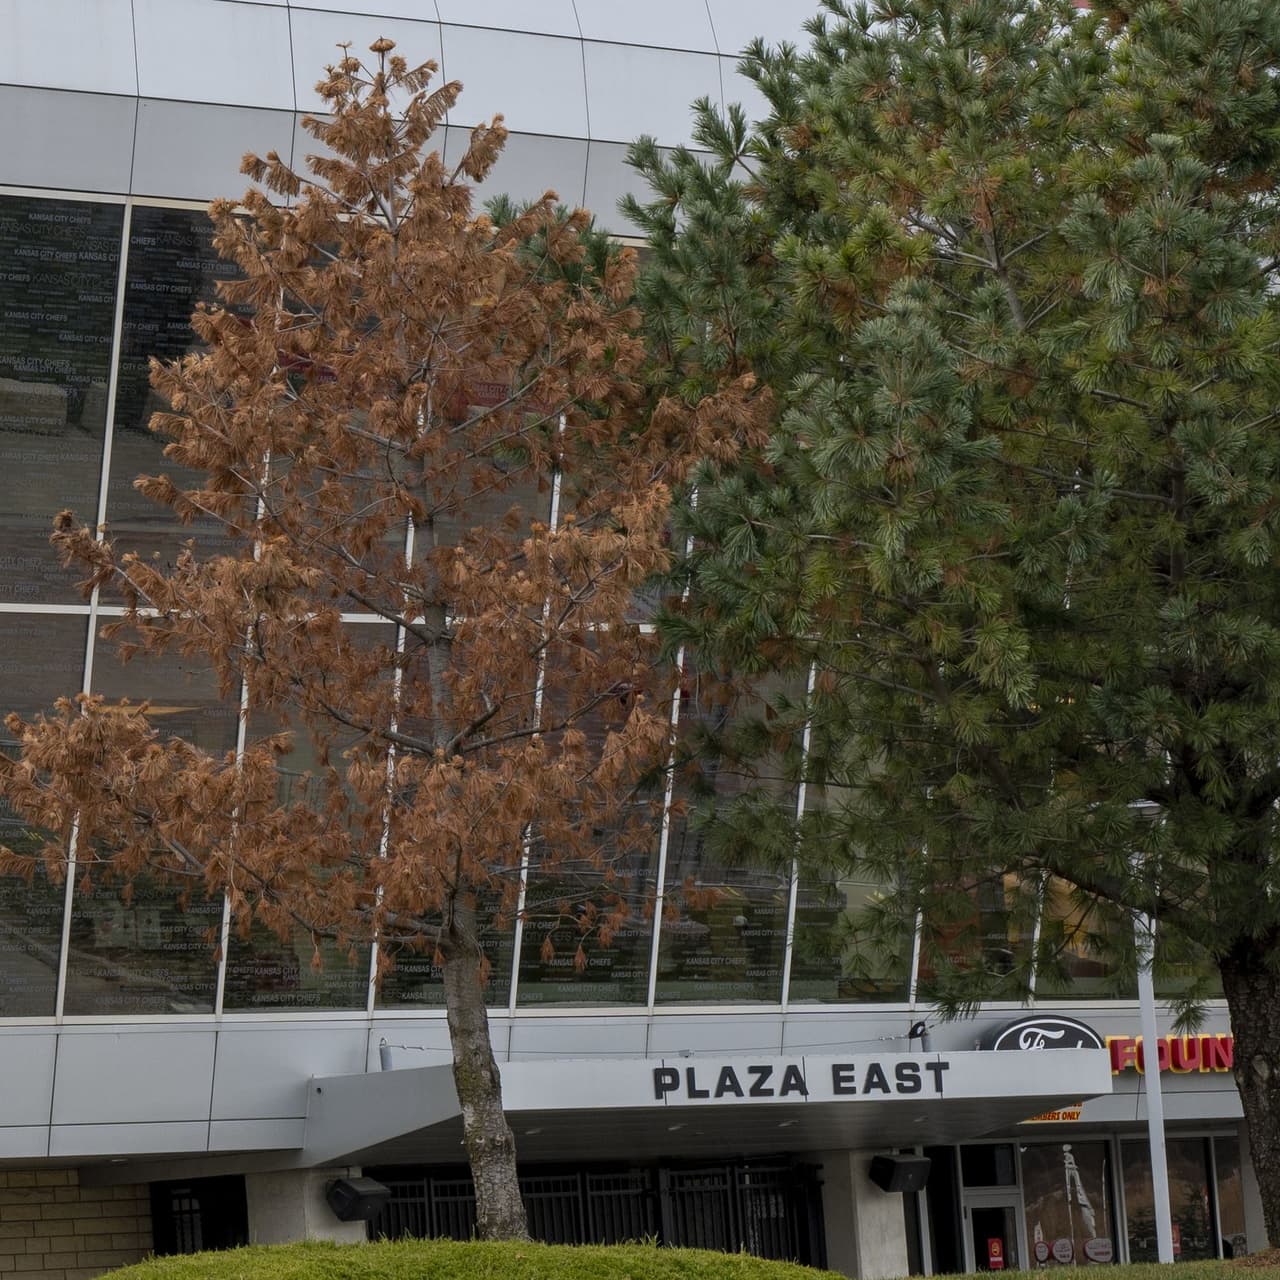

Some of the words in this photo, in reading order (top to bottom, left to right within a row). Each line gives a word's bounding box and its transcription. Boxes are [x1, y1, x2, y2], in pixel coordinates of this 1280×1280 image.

[28, 213, 53, 221] KANSAS
[54, 214, 69, 222] CITY
[70, 215, 92, 224] CHIEFS
[131, 237, 156, 246] CHIEFS
[14, 248, 40, 257] KANSAS
[40, 249, 54, 258] CITY
[55, 251, 77, 261] CHIEFS
[8, 273, 31, 282] CHIEFS
[130, 282, 155, 290] KANSAS
[156, 283, 170, 292] CITY
[171, 284, 192, 294] CHIEFS
[4, 312, 29, 320] KANSAS
[31, 312, 45, 321] CITY
[46, 313, 67, 322] CHIEFS
[653, 1065, 809, 1099] PLAZA
[832, 1062, 949, 1095] EAST
[1061, 1111, 1080, 1120] ONLY
